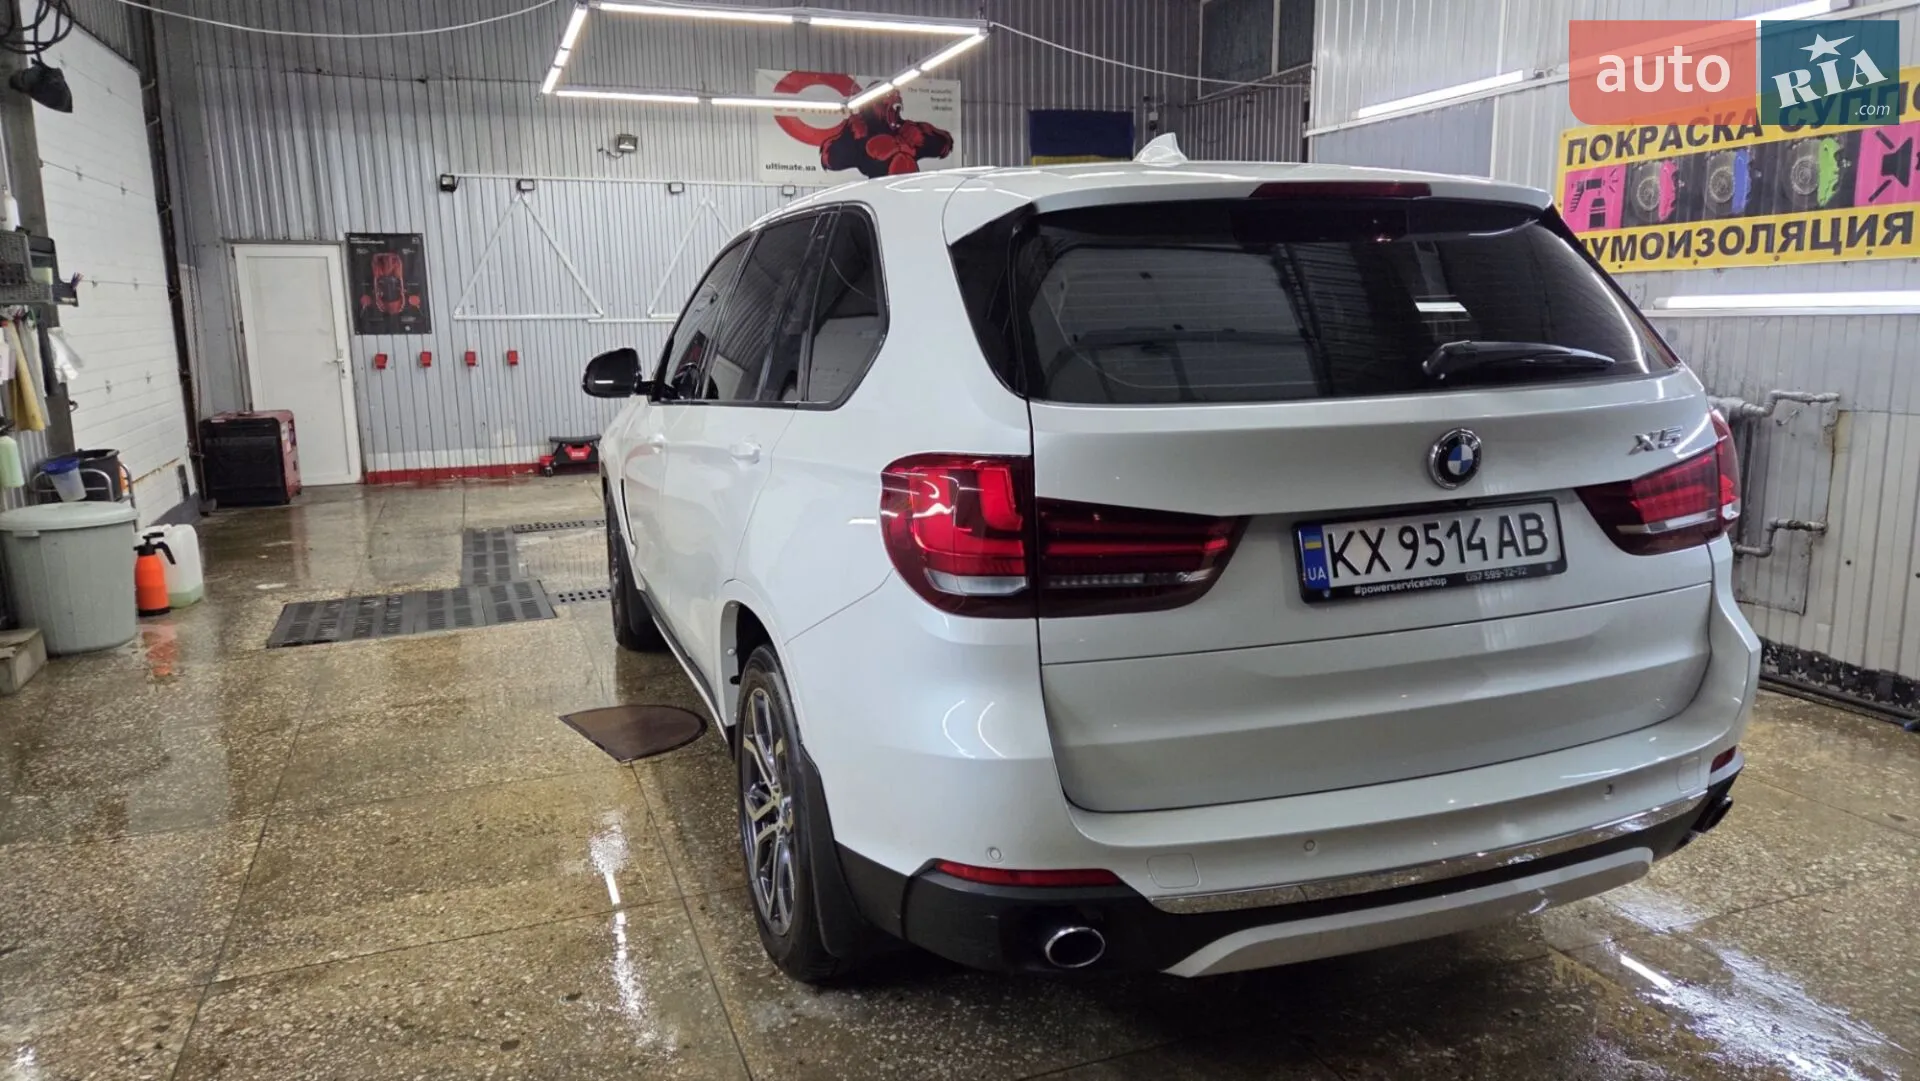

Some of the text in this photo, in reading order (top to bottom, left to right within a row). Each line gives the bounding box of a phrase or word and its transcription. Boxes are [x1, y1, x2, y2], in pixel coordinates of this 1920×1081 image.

[1565, 107, 1764, 167] ПОКРАСКА
[765, 162, 817, 172] ultimate.ua
[1580, 210, 1914, 263] УМОИЗОЛЯЦИЯ
[1627, 426, 1683, 456] X5
[1327, 512, 1549, 579] KX 9514 AB
[1307, 566, 1327, 581] UA
[1354, 576, 1447, 597] #powerserviceshop
